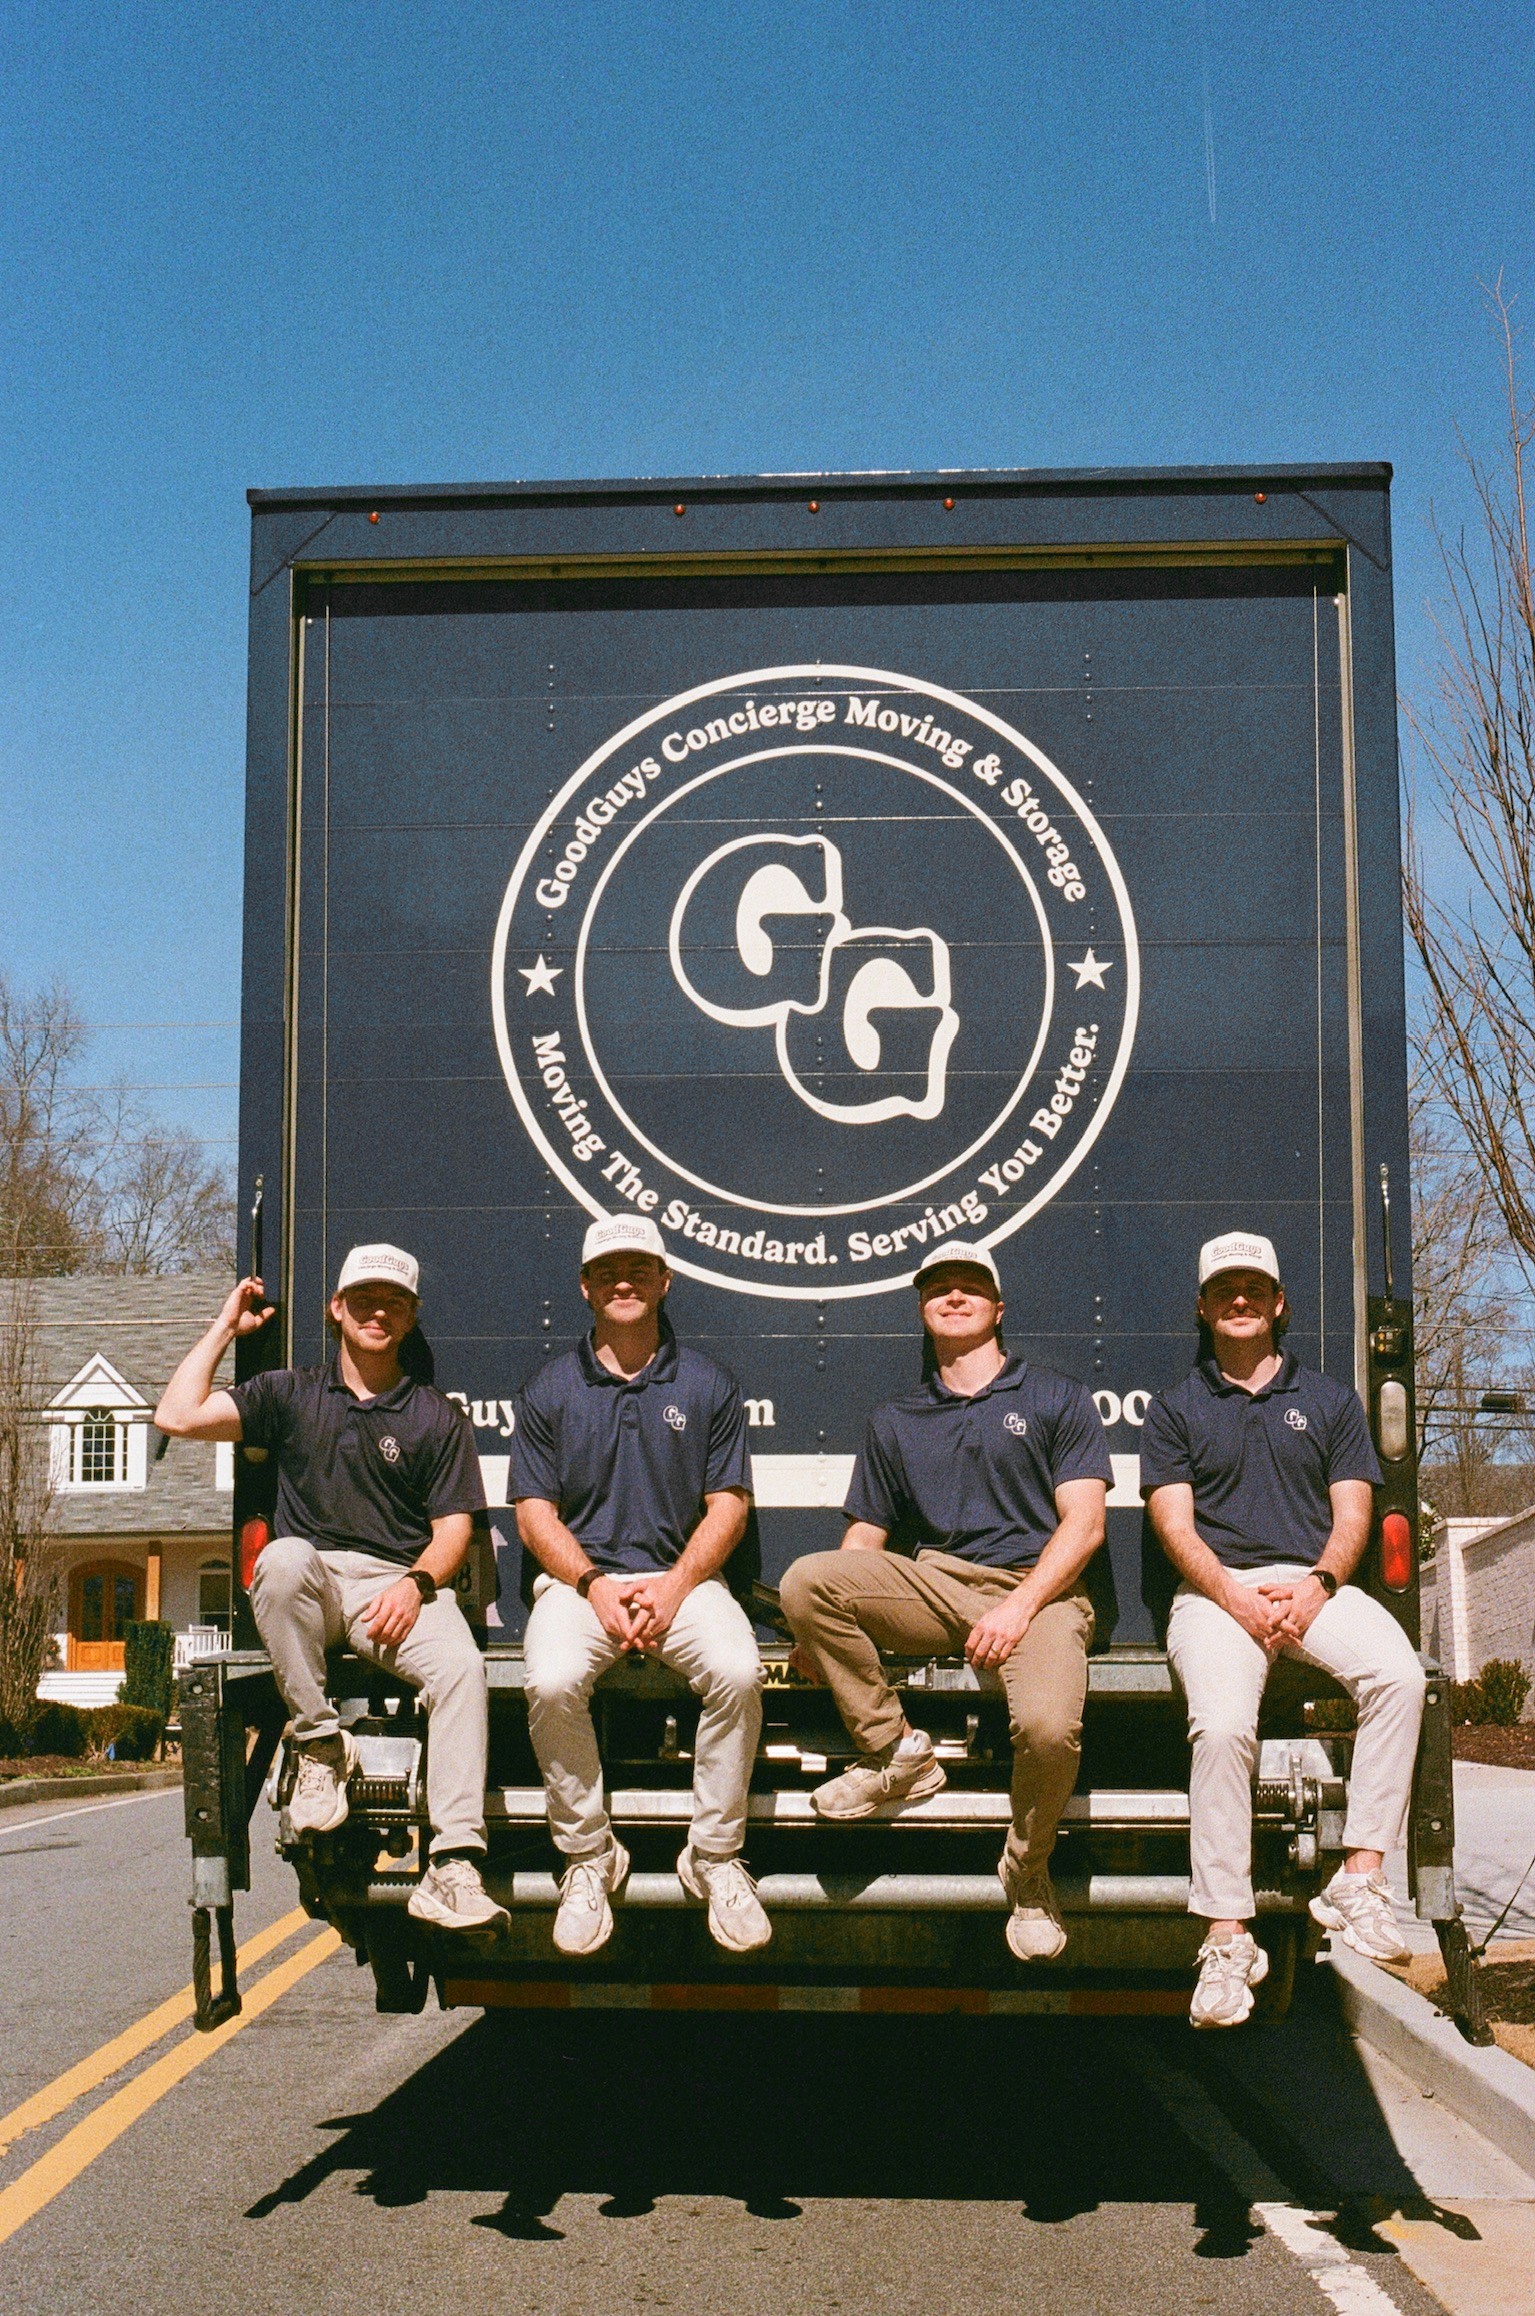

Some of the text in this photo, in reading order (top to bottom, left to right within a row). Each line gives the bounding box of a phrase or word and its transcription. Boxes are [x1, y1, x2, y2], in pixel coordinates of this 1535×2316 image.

[535, 695, 1087, 909] GoodGuys Concierge Moving & Storage
[531, 1022, 1100, 1265] Moving The Standard. Serving You Better.
